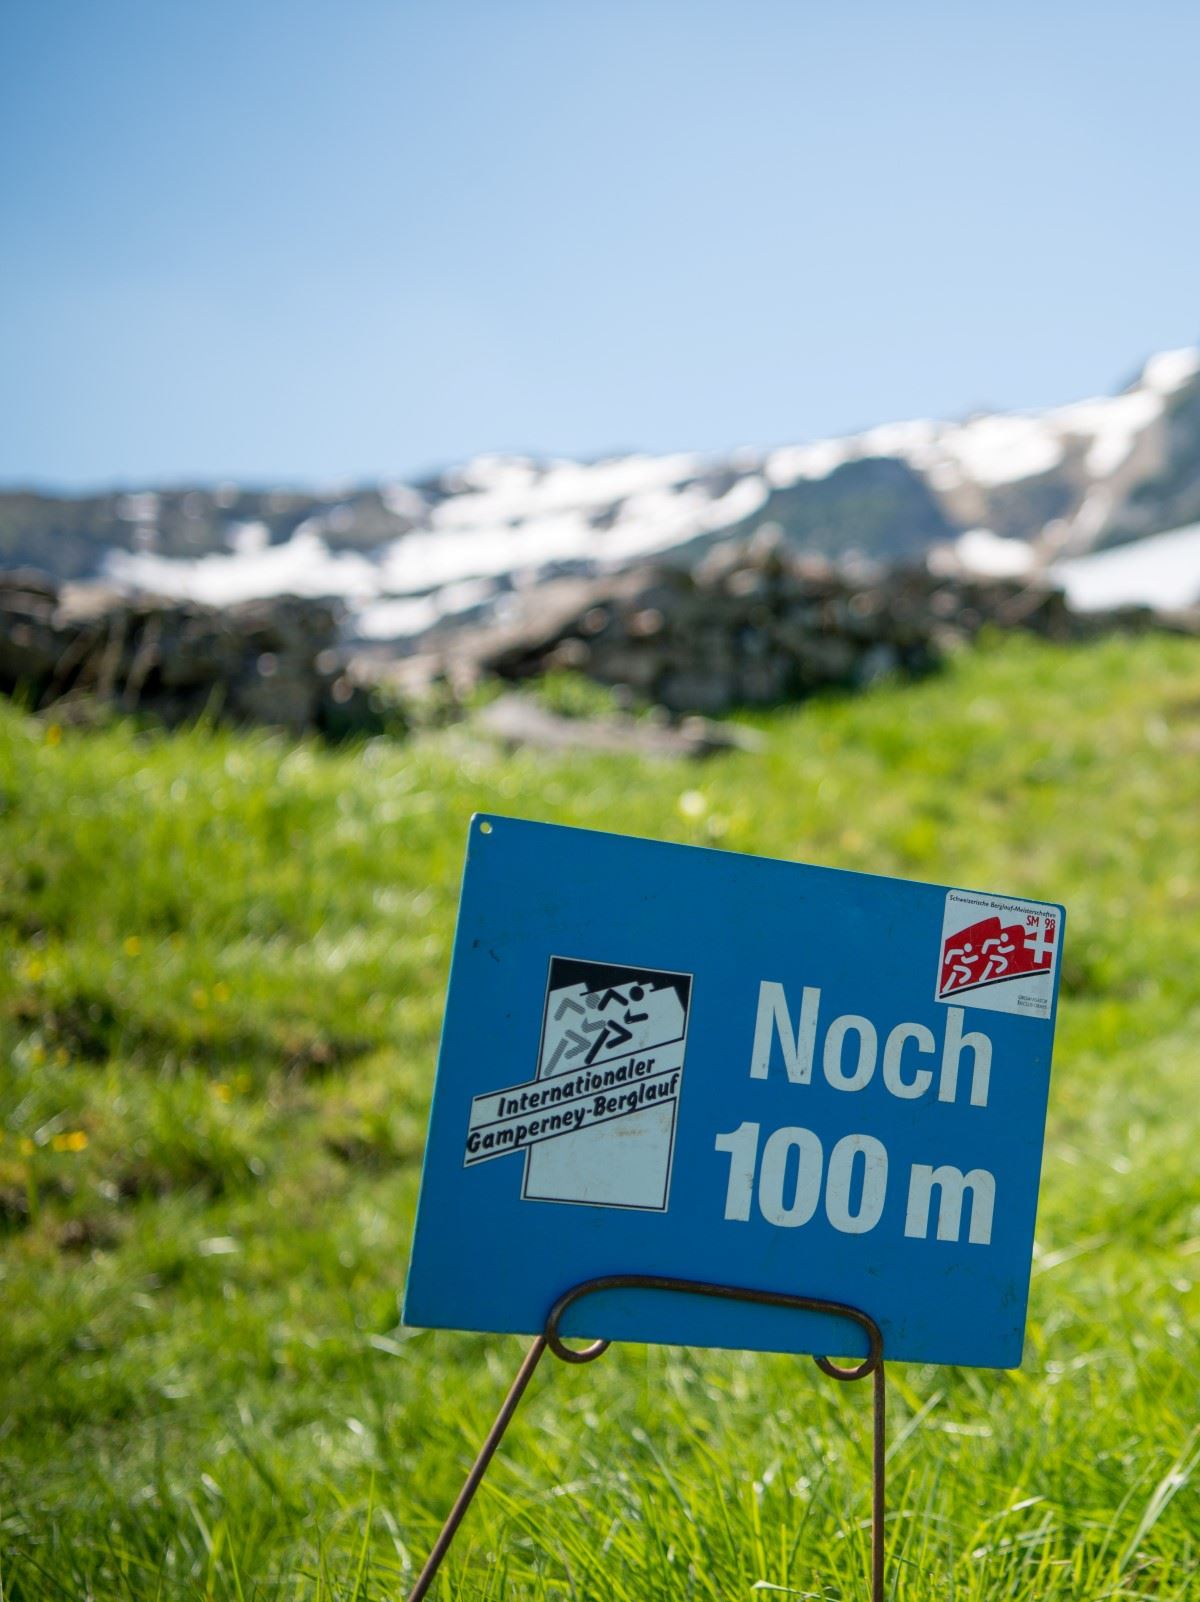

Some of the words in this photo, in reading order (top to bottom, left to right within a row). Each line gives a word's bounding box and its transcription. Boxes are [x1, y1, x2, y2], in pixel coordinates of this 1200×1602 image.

[949, 894, 989, 907] Schweizerische
[990, 901, 1056, 918] Berglauf-Meisterschaften
[1026, 915, 1039, 927] SM
[1045, 917, 1056, 929] 98
[749, 980, 993, 1107] Noch
[466, 1073, 680, 1153] Gamperney-Berglauf
[497, 1056, 656, 1117] Internationaler
[714, 1121, 888, 1235] 100
[904, 1163, 996, 1247] m
